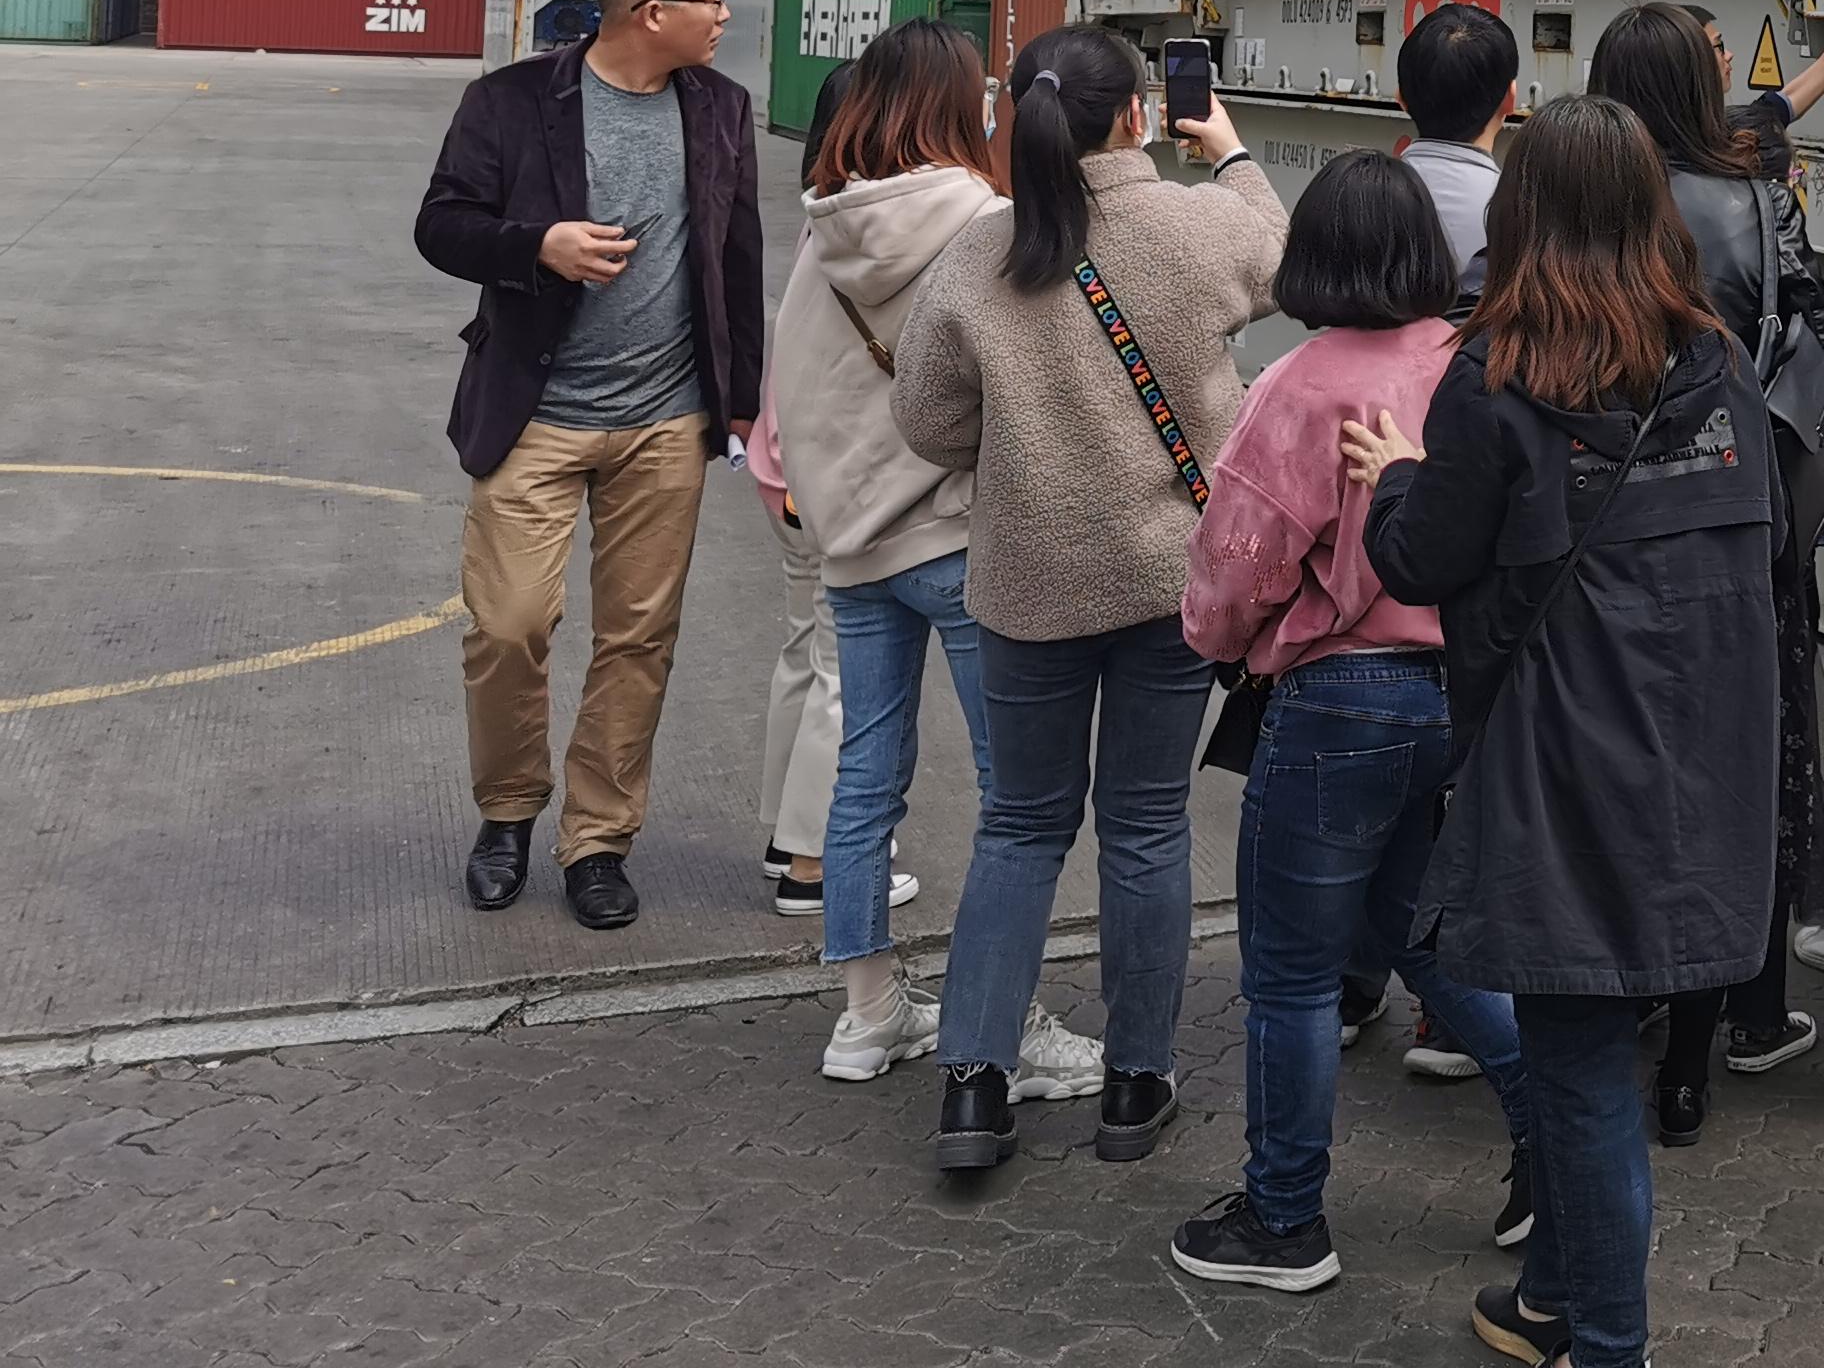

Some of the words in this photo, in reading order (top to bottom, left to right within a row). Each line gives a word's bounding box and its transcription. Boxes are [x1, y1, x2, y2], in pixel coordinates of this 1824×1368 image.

[365, 7, 426, 32] ZIM
[1074, 260, 1108, 305] LOVE
[1097, 301, 1131, 346] LOVE
[1120, 343, 1151, 386] LOVE
[1141, 383, 1171, 425] LOVE
[1161, 422, 1190, 464] LOVE
[1181, 461, 1209, 503] LOVE
